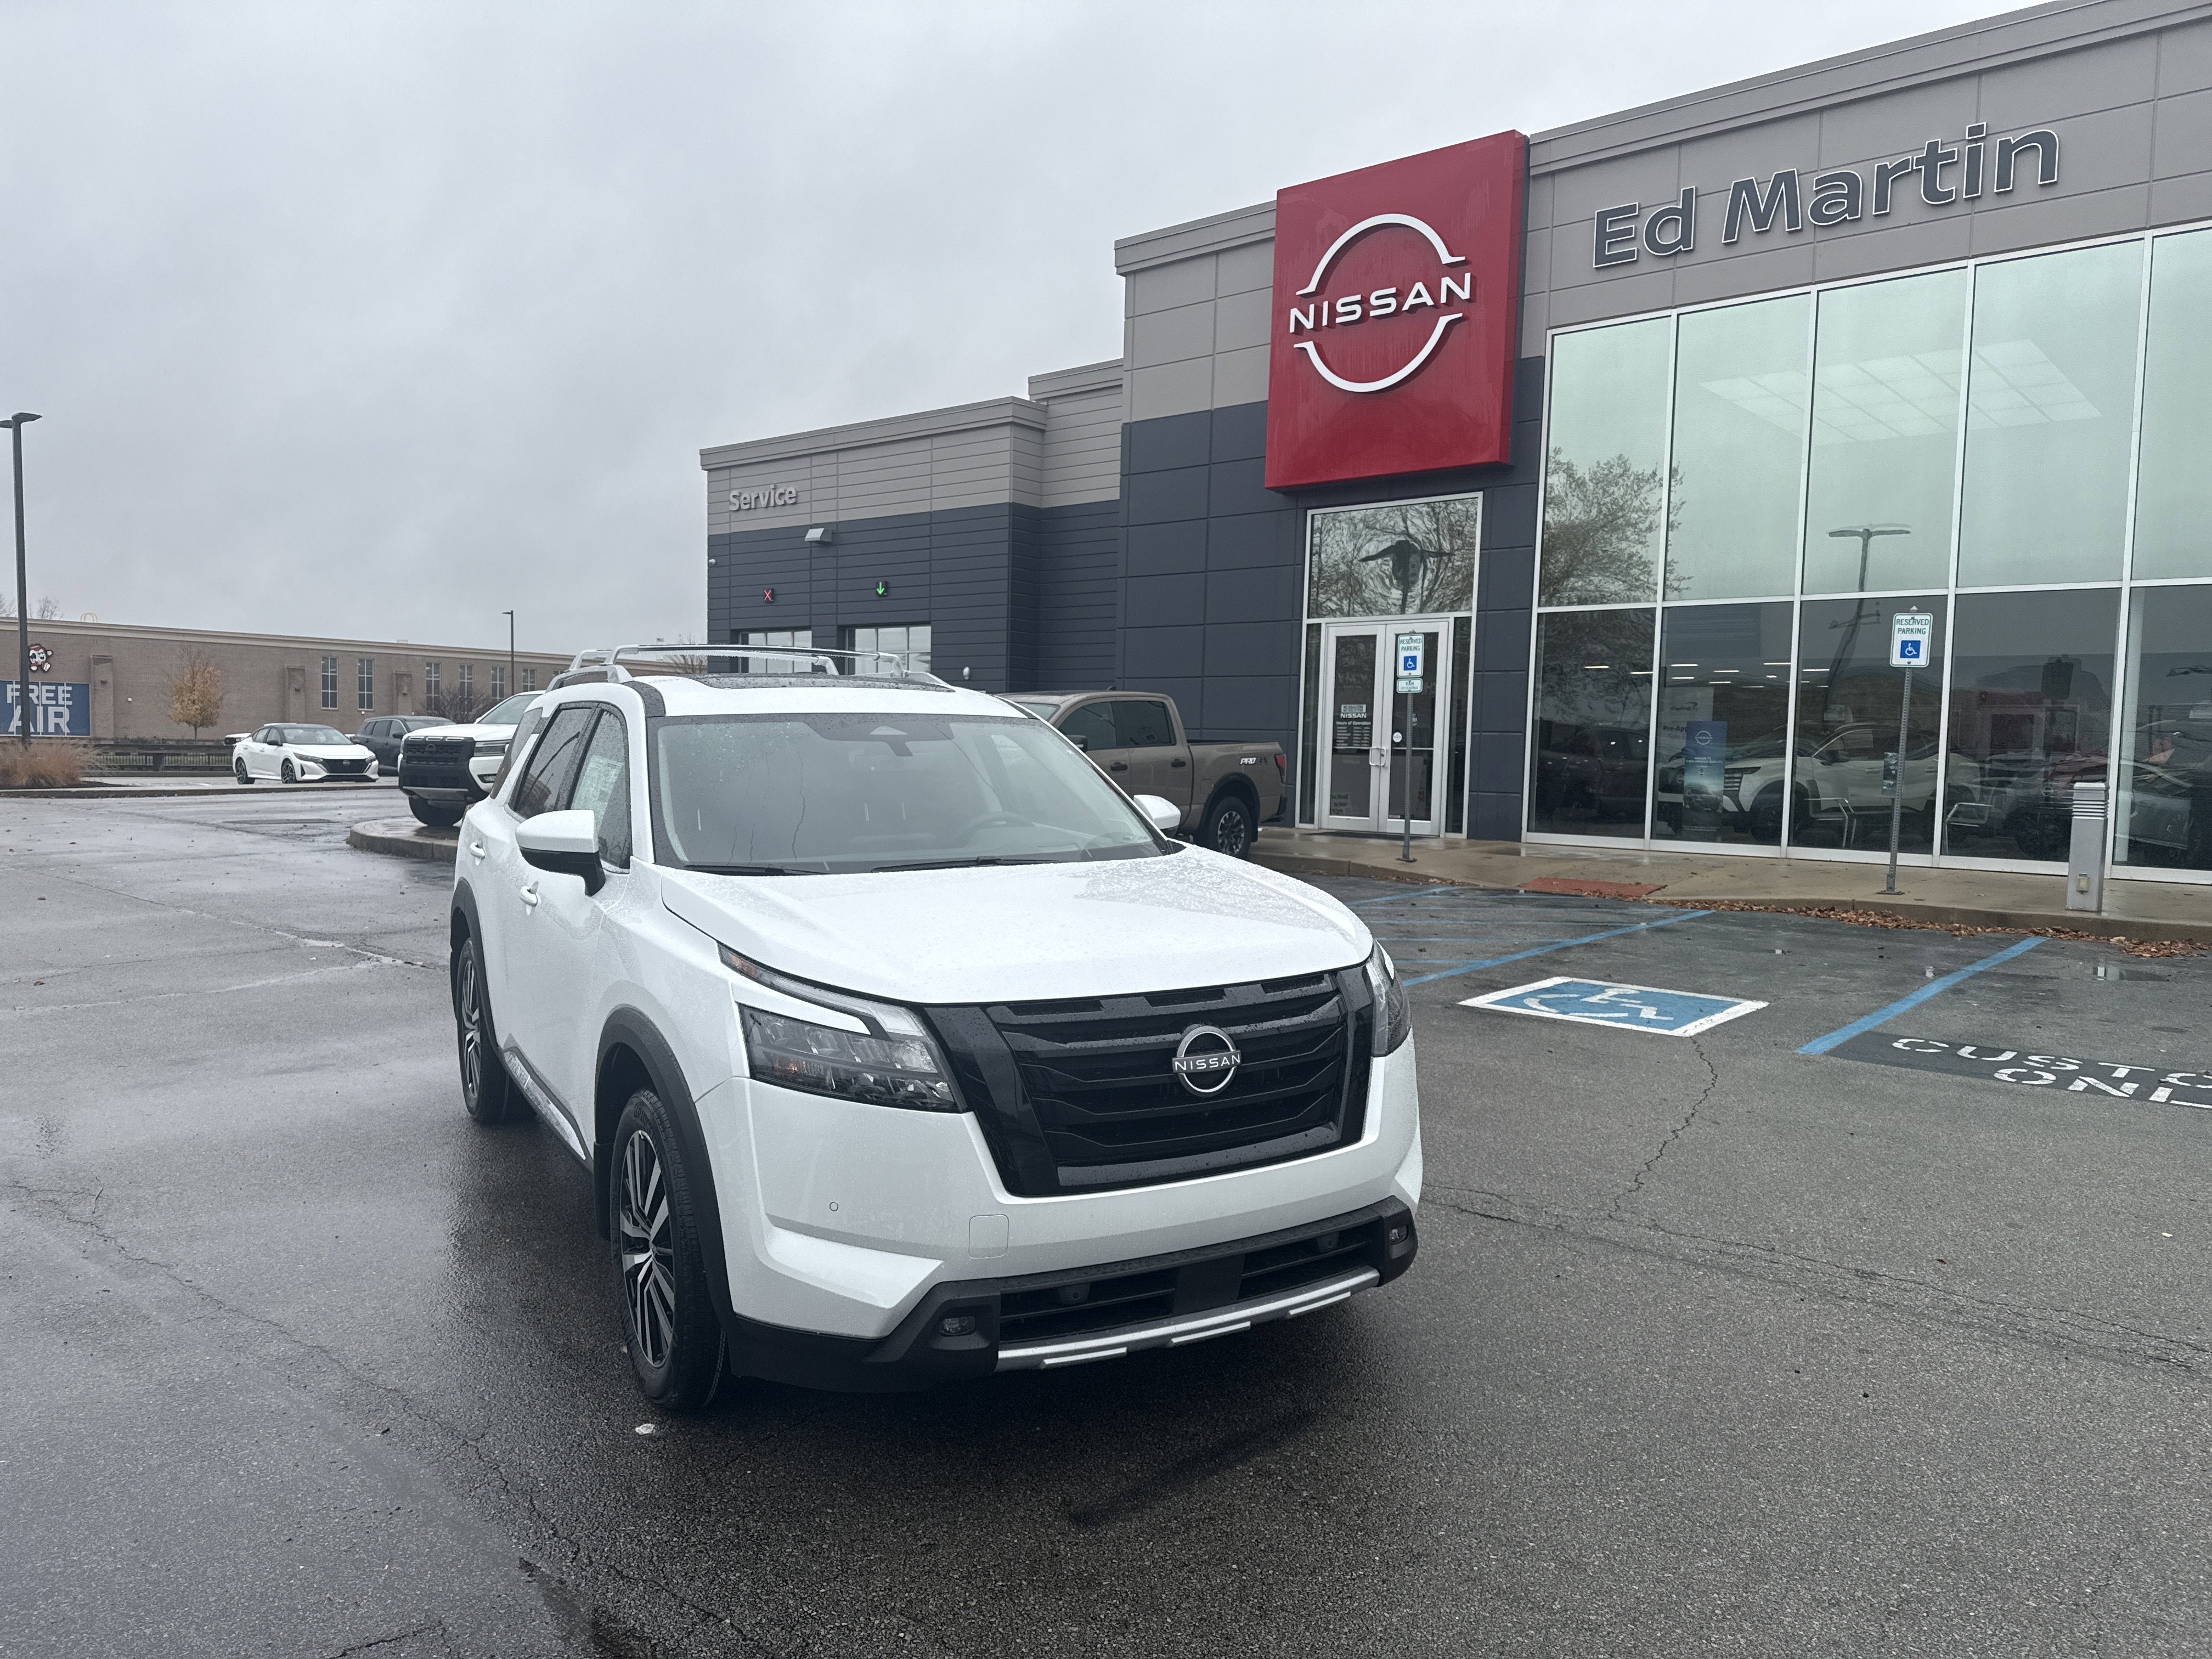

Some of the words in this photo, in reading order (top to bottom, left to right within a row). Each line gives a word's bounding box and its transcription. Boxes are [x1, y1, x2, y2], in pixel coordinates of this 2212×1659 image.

[1593, 185, 1697, 269] Ed
[1722, 122, 2060, 245] Martin
[1289, 272, 1471, 334] NISSAN
[729, 483, 797, 511] Service
[7, 684, 72, 705] FREE
[1175, 1053, 1240, 1071] NISSAN
